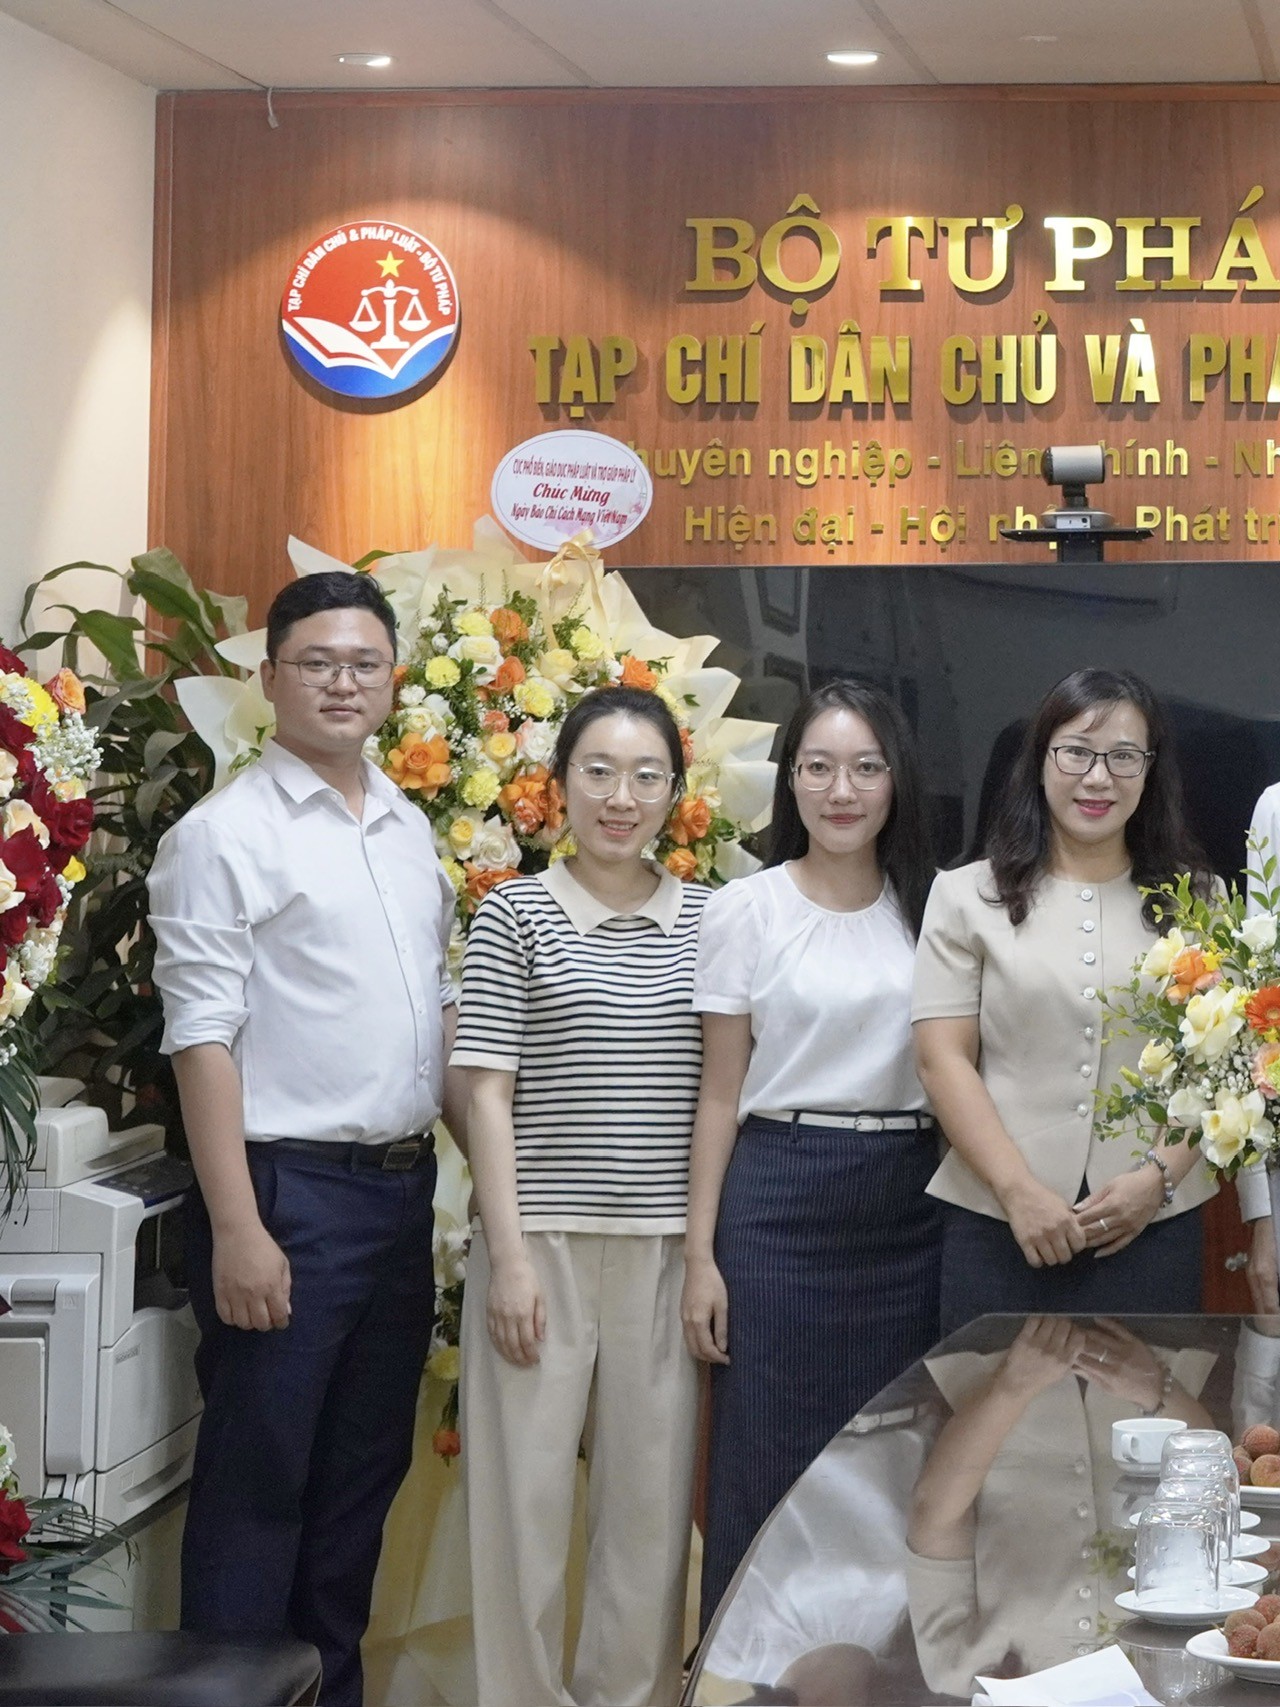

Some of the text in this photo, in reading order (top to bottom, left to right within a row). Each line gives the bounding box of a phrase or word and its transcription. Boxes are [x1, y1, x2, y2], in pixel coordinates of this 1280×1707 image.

[685, 194, 841, 316] BỘ
[866, 204, 1024, 294] TƯ
[528, 334, 638, 418] TẠP
[666, 320, 767, 403] CHÍ
[790, 319, 911, 403] DÂN
[939, 309, 1057, 405] CHỦ
[1084, 318, 1161, 404] VÀ
[628, 438, 751, 486] huyên
[769, 440, 913, 487] nghiệp
[1098, 438, 1188, 476] hính
[533, 480, 611, 506] Chúc Mừng
[684, 504, 777, 550] Hiện
[792, 506, 855, 554] đại
[901, 505, 967, 552] Hội
